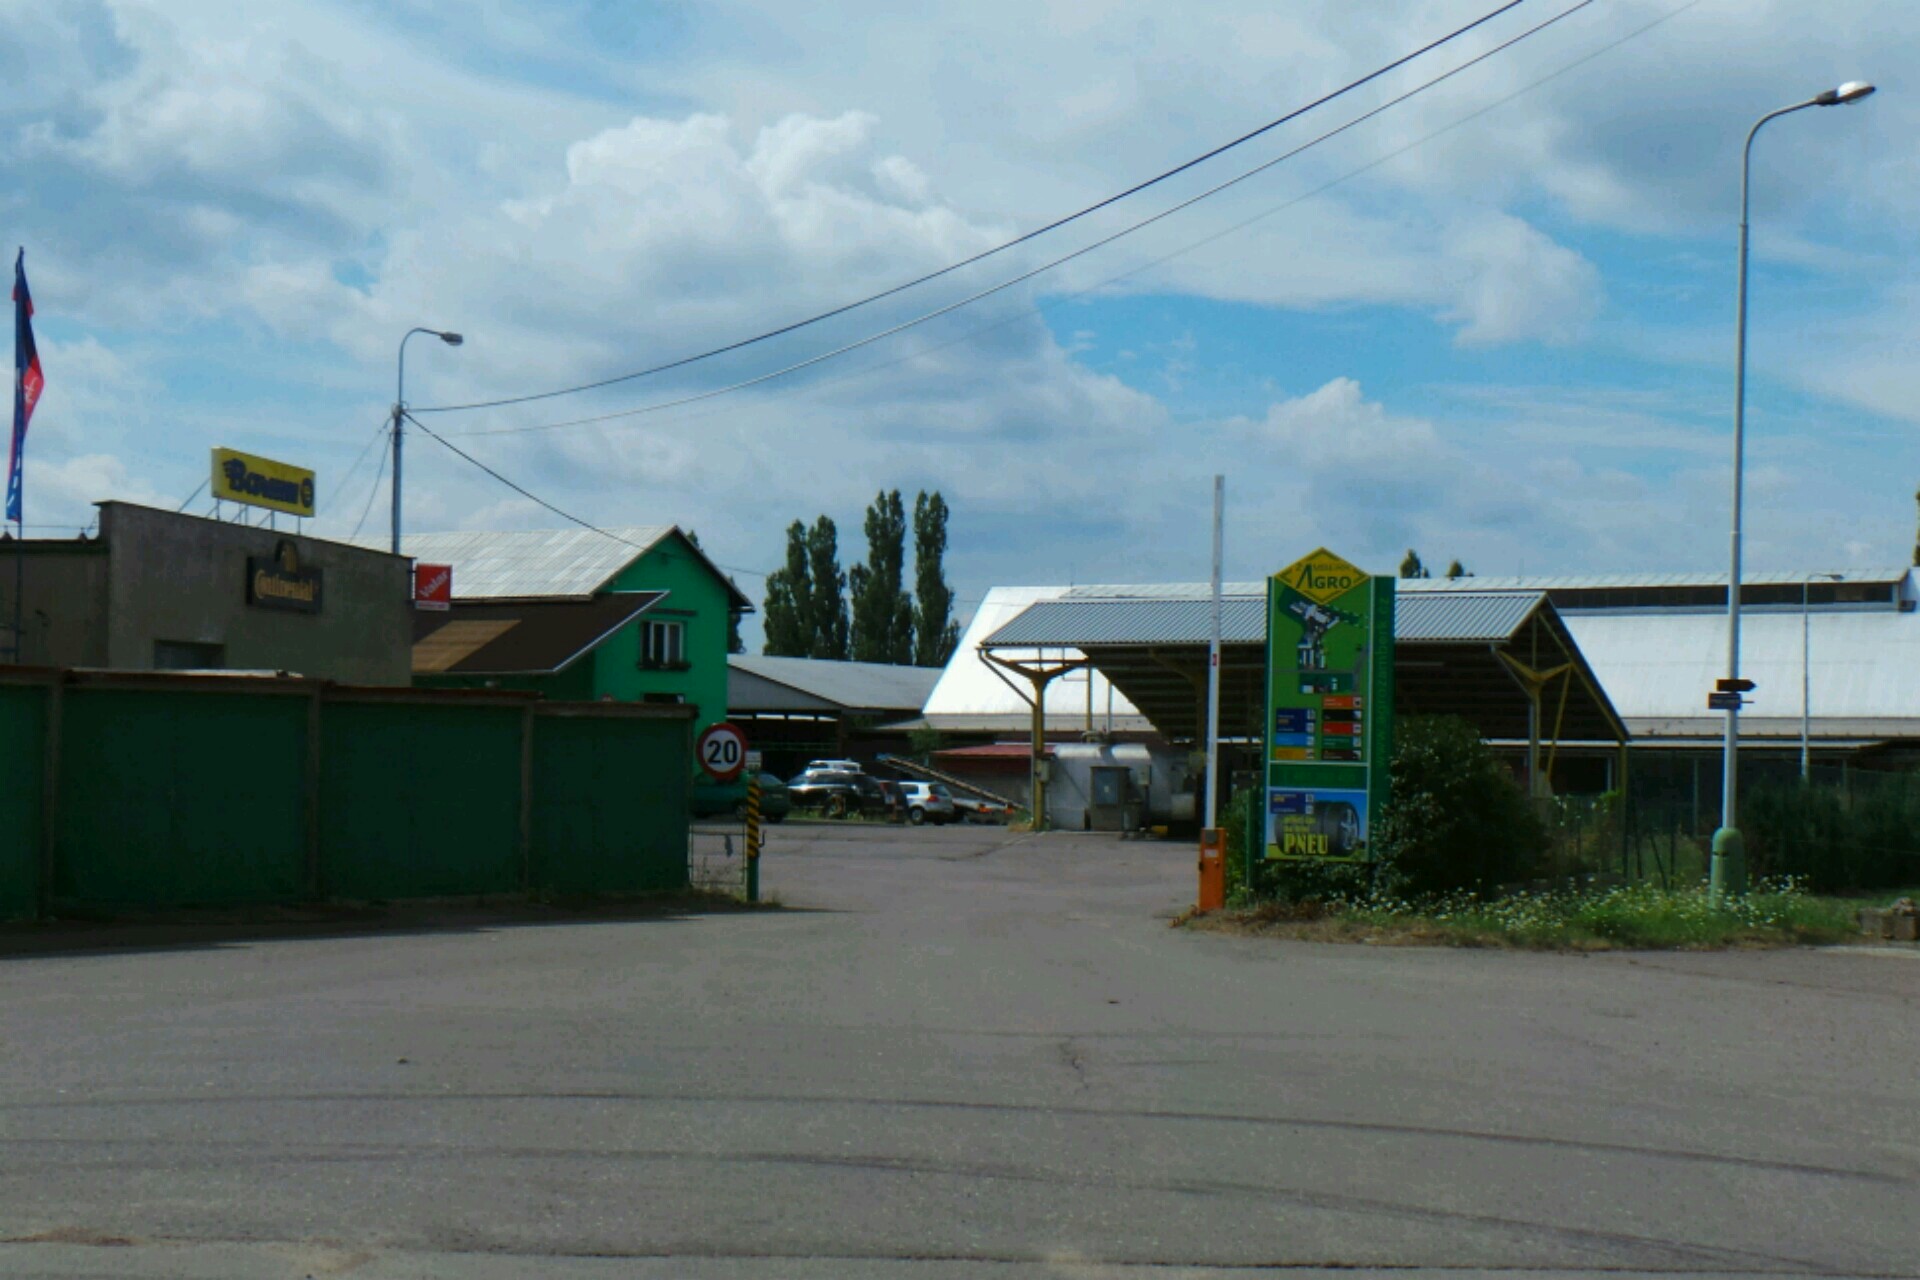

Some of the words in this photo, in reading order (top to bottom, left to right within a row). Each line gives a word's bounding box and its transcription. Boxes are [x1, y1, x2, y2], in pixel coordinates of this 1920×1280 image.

[1296, 563, 1352, 589] AGRO
[707, 739, 738, 765] 20
[1283, 832, 1329, 855] PNEU
